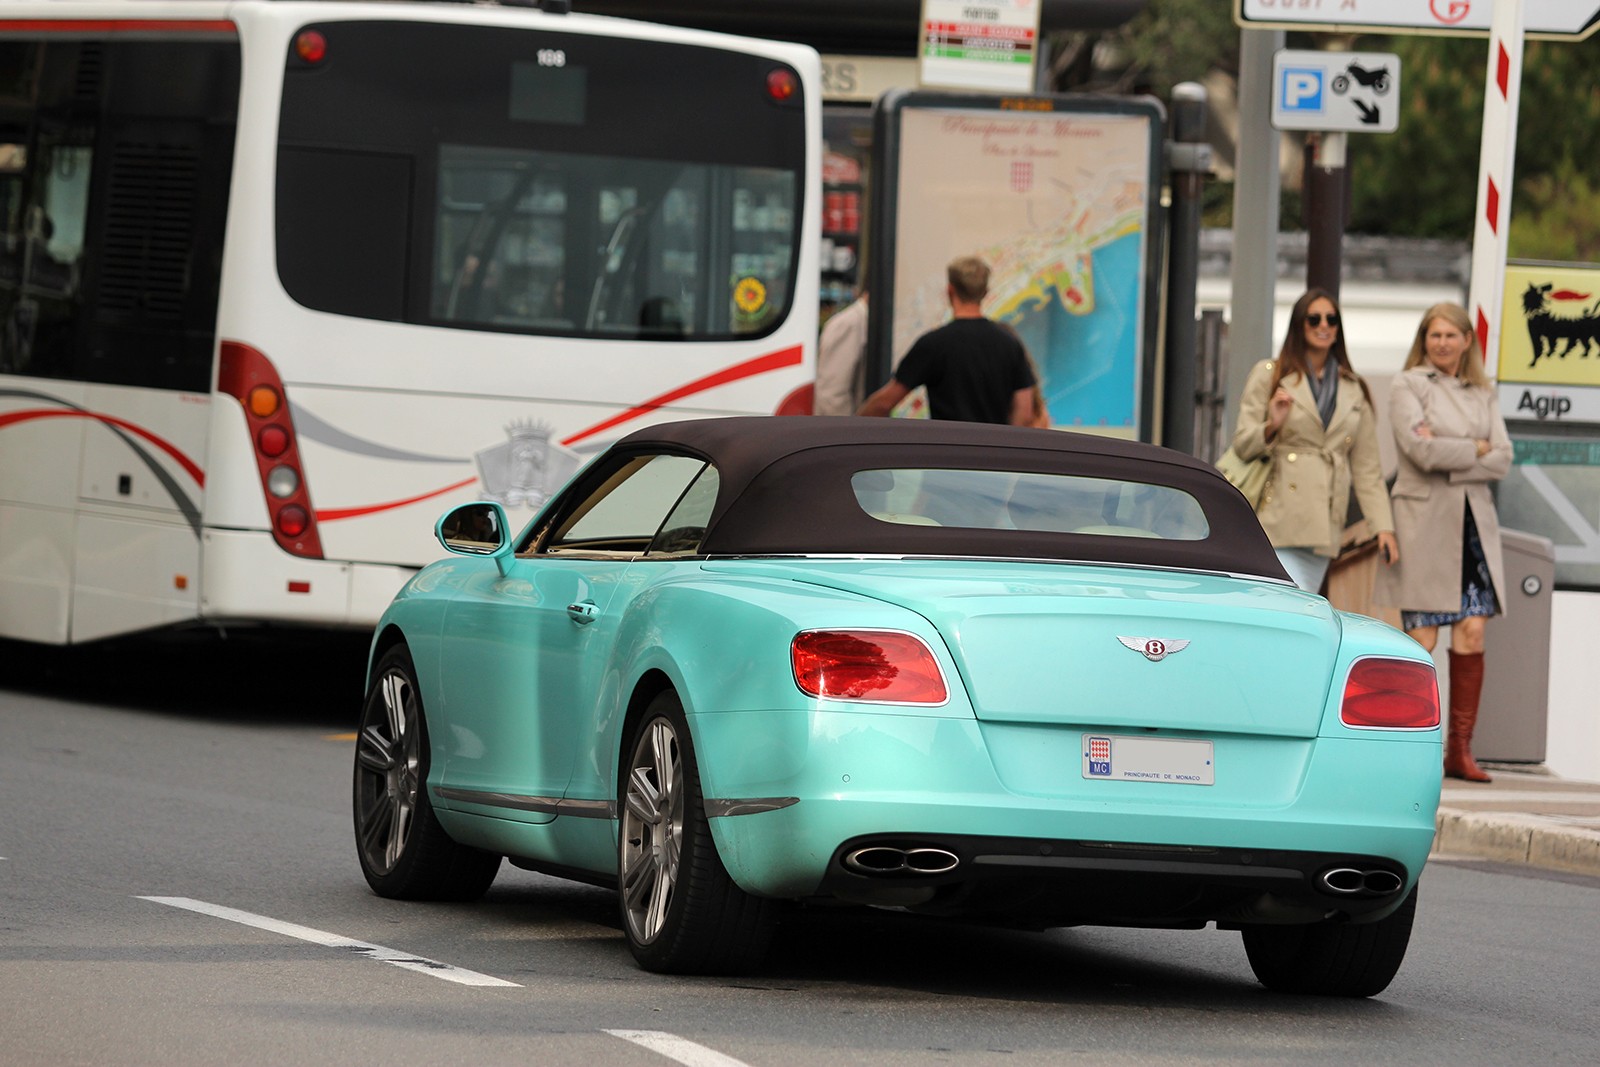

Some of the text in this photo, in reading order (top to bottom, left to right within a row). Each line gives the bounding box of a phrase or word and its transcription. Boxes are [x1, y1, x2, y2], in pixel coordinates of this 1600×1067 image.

[1285, 72, 1320, 107] P
[1517, 389, 1571, 419] Agip
[1094, 763, 1108, 773] MC
[1124, 771, 1160, 779] PRINCIPAUTE
